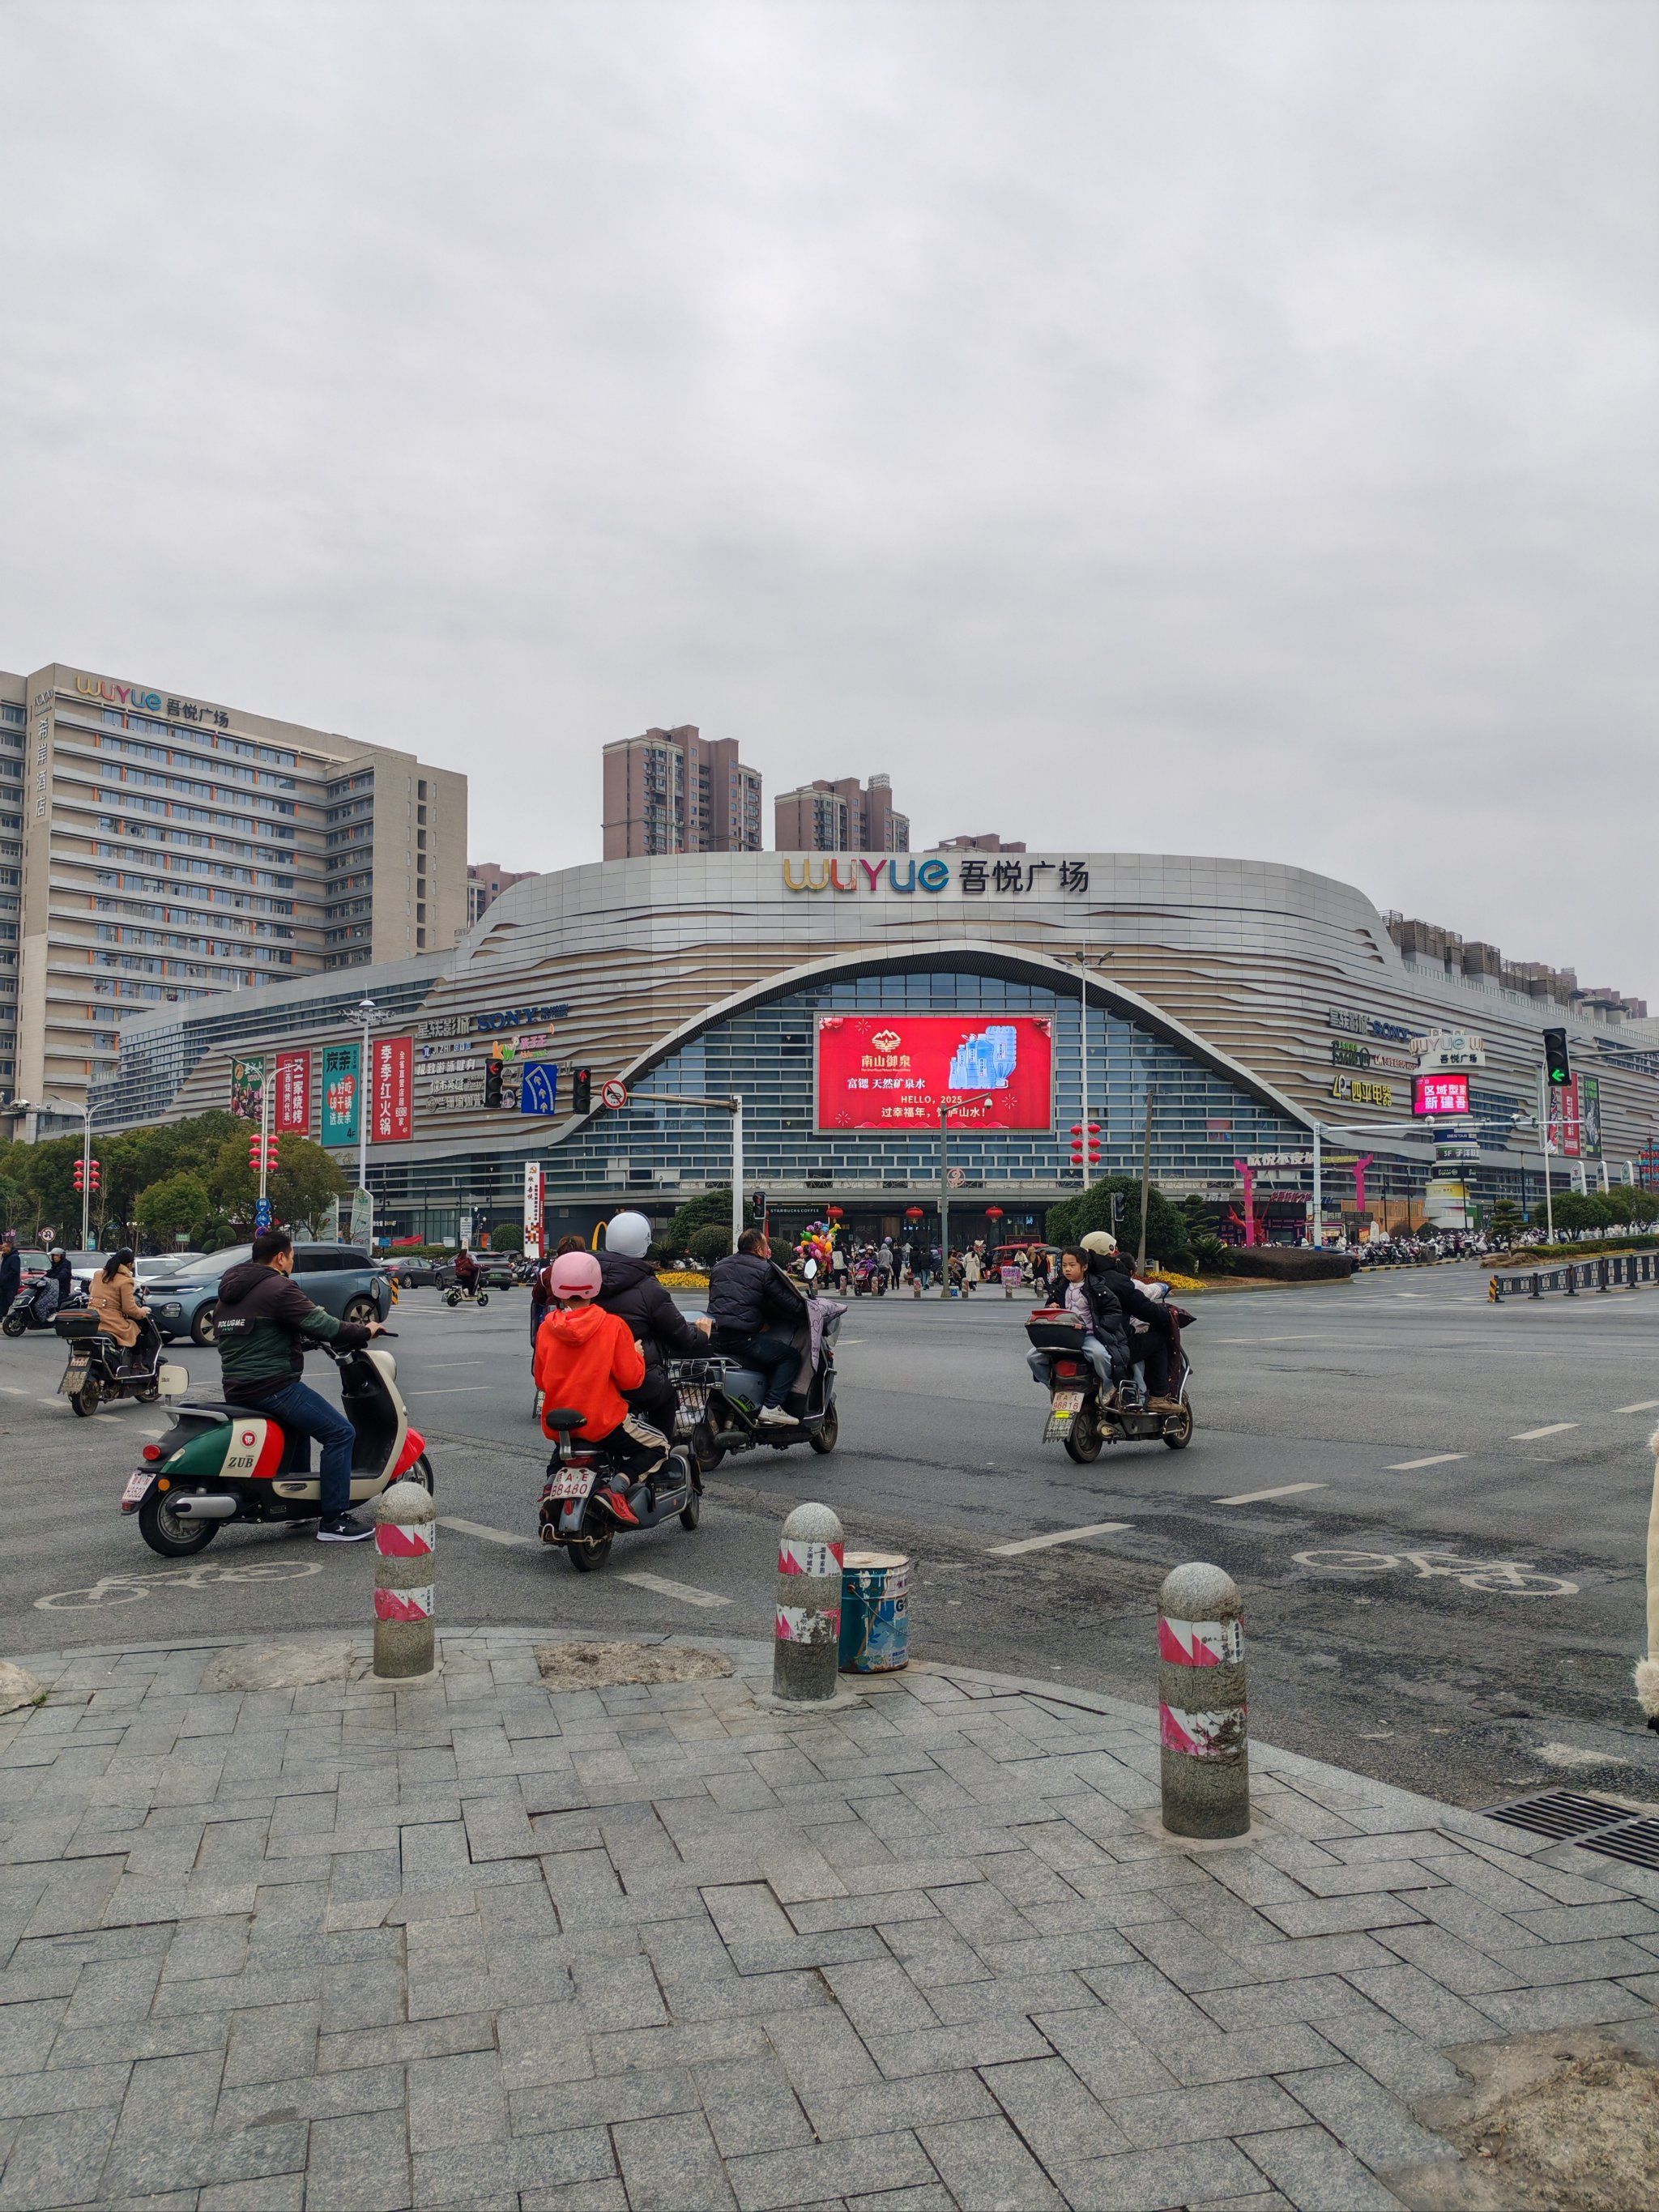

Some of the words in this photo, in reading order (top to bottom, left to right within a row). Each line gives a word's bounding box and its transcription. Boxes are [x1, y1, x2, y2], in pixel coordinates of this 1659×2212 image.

[166, 697, 229, 728] 吾悦广场
[36, 718, 49, 817] 希岸酒店
[958, 860, 1089, 893] 吾悦广场
[477, 1007, 538, 1032] SONY
[861, 1055, 911, 1068] 南山御泉
[1440, 1054, 1478, 1063] 吾悦广场
[415, 1058, 476, 1076] 极致游泳健身
[337, 1081, 352, 1095] 好吃
[380, 1045, 392, 1136] 季季红火锅
[872, 1077, 926, 1089] 天然矿泉水
[940, 1095, 962, 1104] 2025
[1351, 1080, 1392, 1107] 四平电器
[347, 1127, 356, 1139] 4F
[228, 1457, 254, 1468] ZUB
